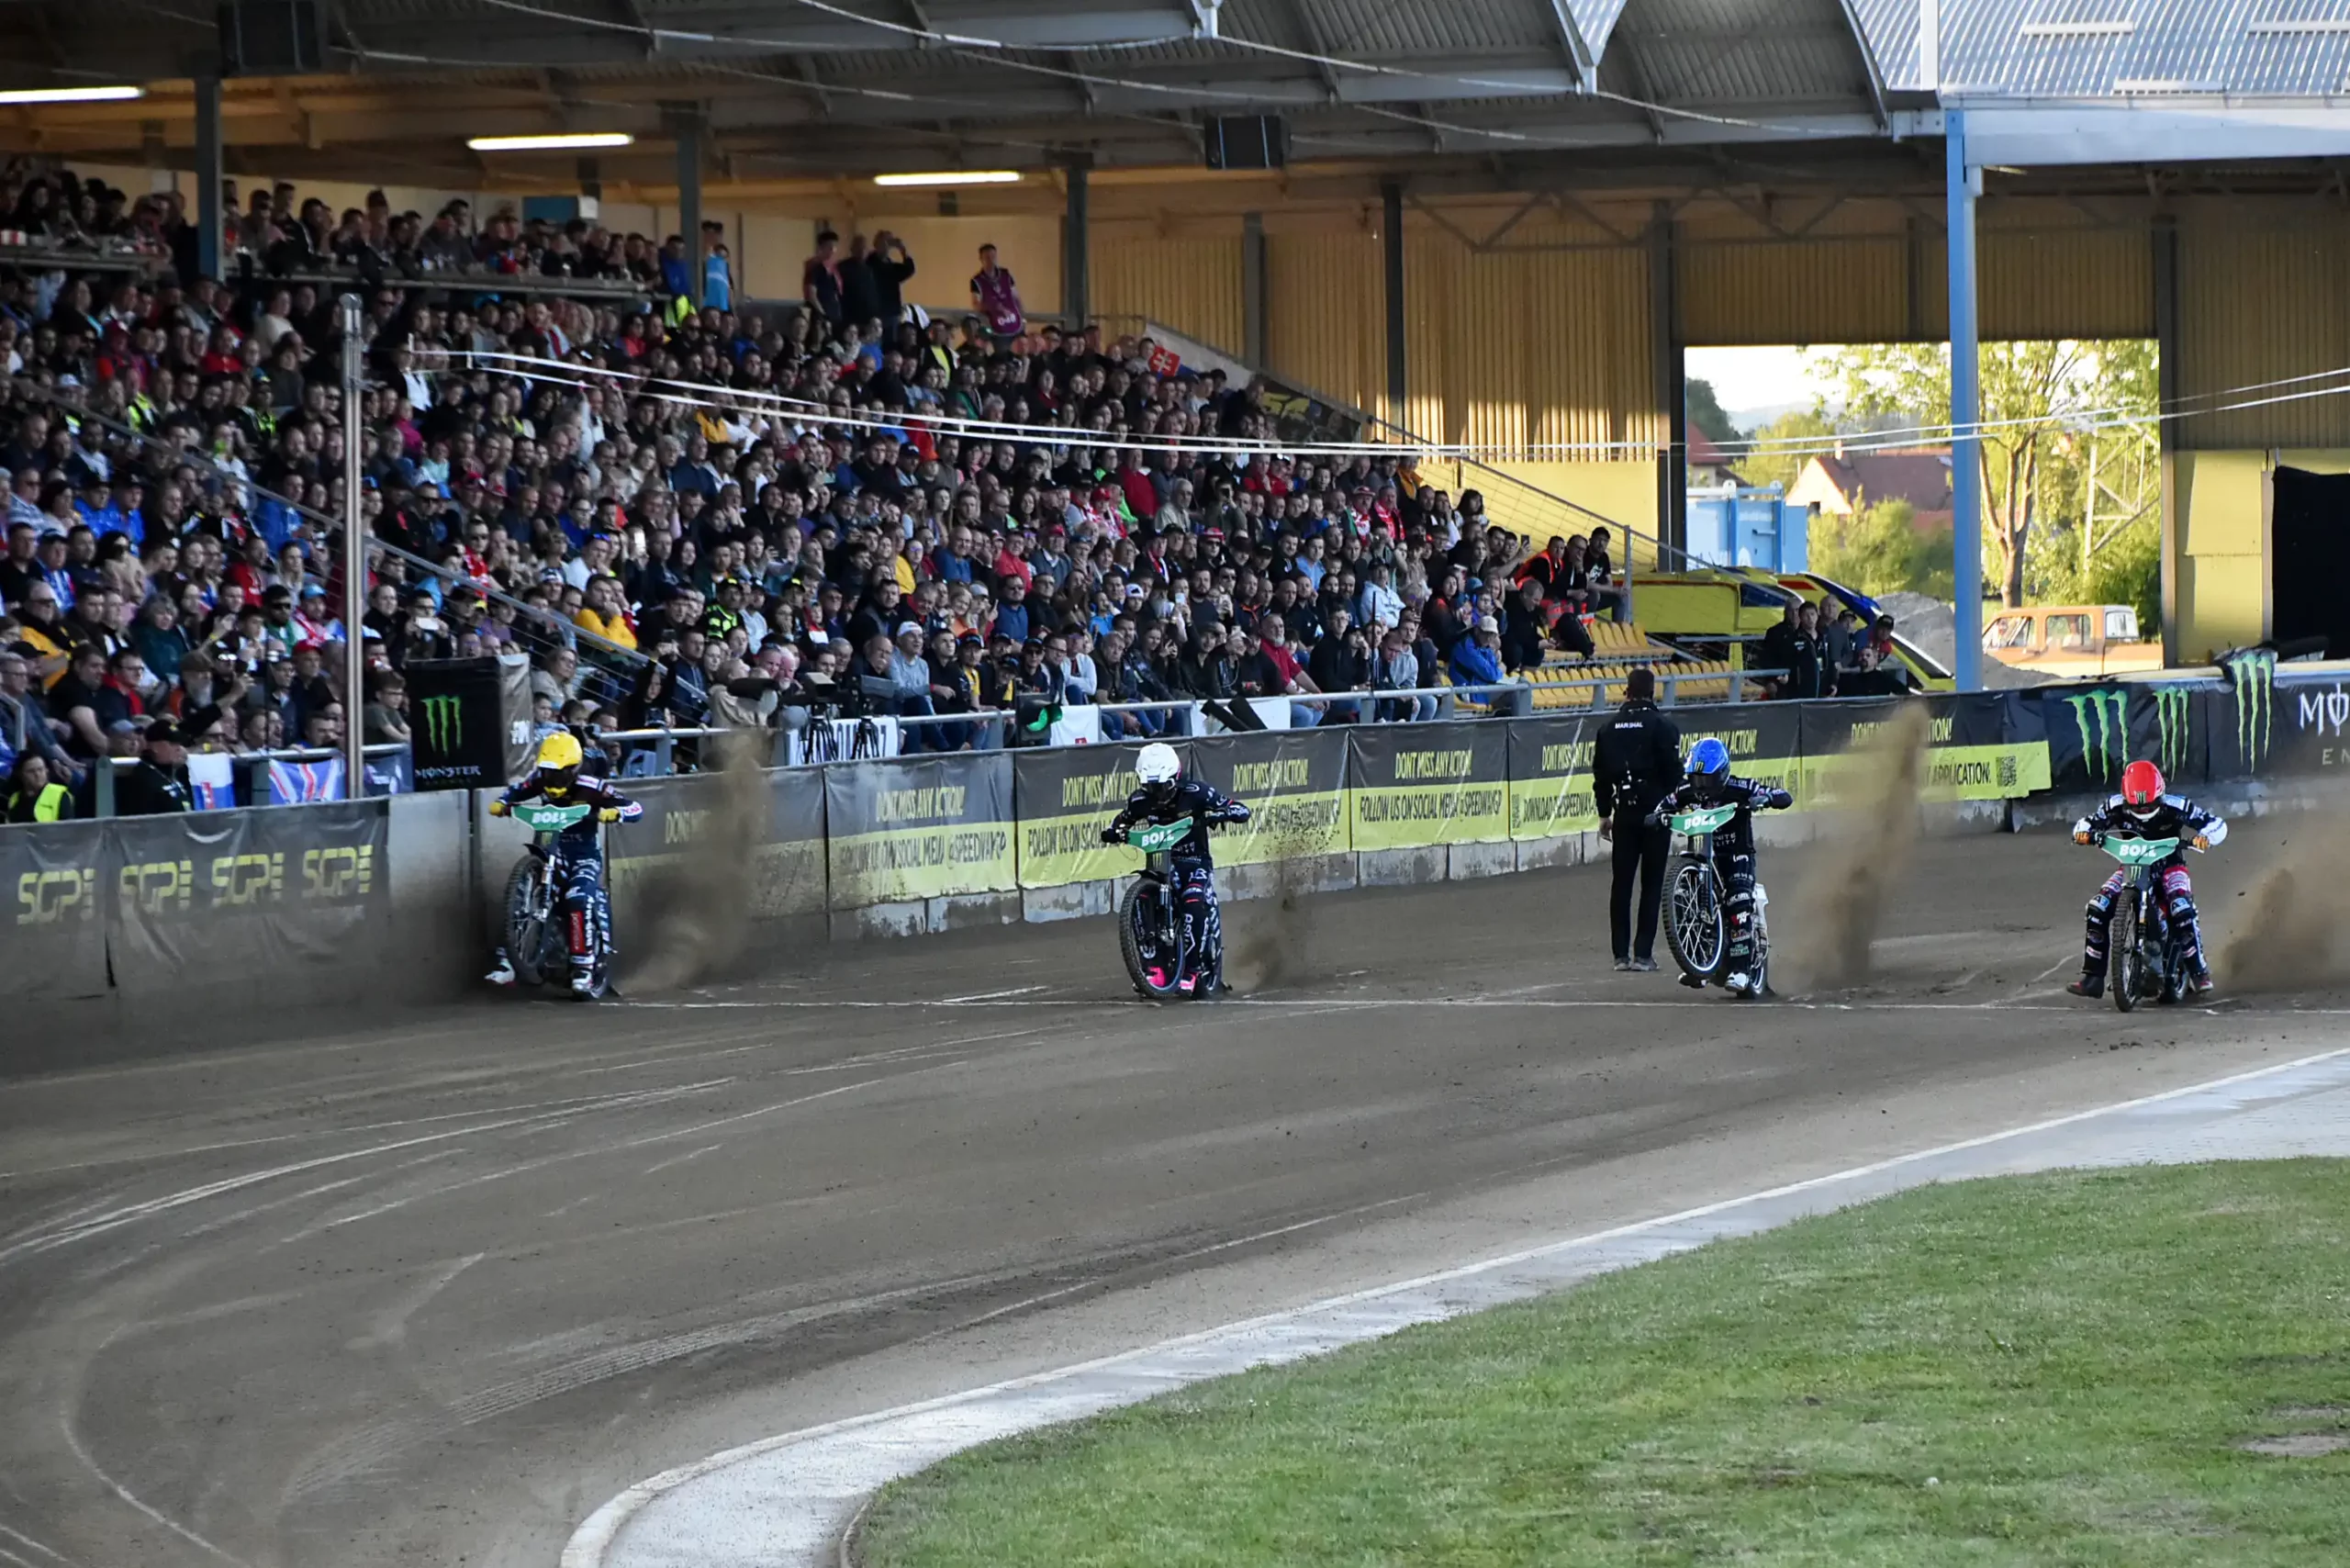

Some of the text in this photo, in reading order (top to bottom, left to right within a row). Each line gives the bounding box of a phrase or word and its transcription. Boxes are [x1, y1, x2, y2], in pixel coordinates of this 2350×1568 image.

[1729, 729, 1757, 755] ACTION!
[1417, 751, 1435, 778] MISS
[1435, 750, 1449, 778] ANY
[1084, 774, 1103, 806] MISS
[1102, 772, 1120, 803] ANY
[532, 812, 568, 824] BOLL
[1360, 795, 1388, 823] FOLLOW
[1391, 795, 1401, 822] US
[1401, 794, 1412, 821] ON
[1413, 793, 1438, 820] SOCIAL
[1684, 814, 1717, 831] BOLL
[1028, 826, 1057, 858] FOLLOW
[1058, 825, 1069, 855] US
[1069, 823, 1080, 854] ON
[1141, 829, 1175, 847] BOLL
[2119, 844, 2157, 857] BOLL
